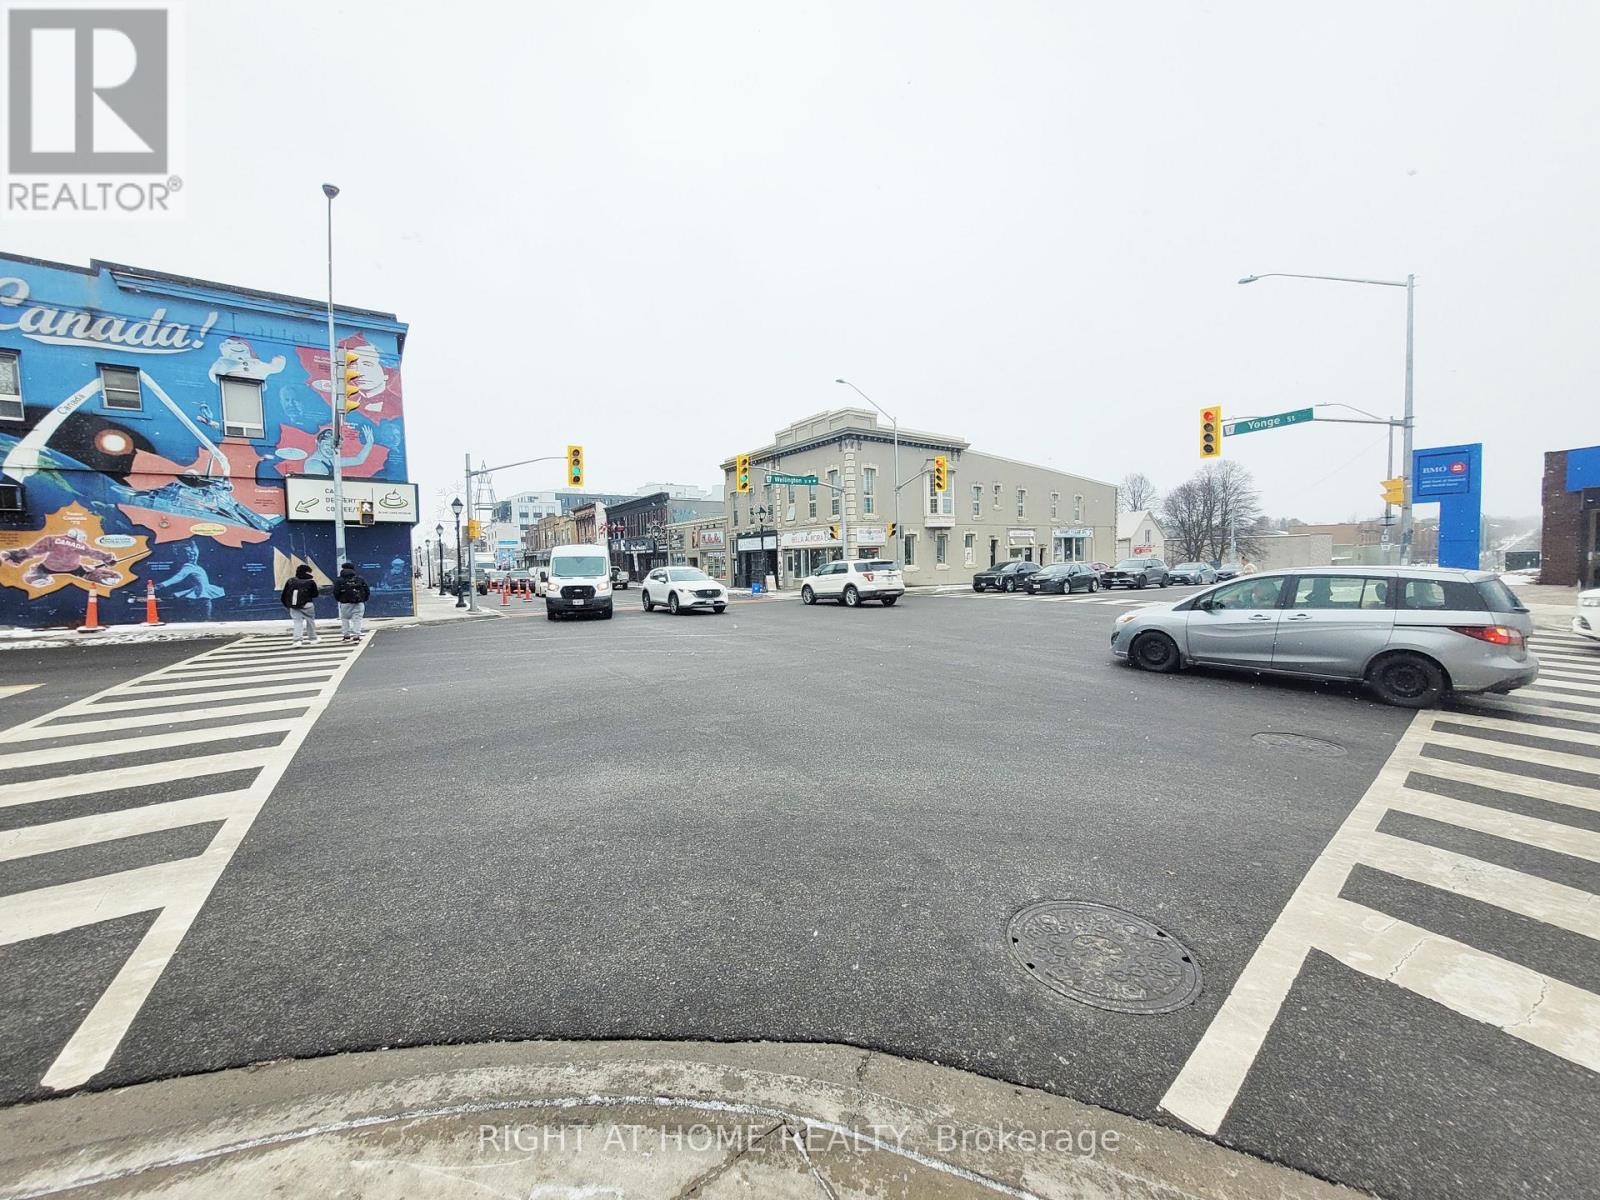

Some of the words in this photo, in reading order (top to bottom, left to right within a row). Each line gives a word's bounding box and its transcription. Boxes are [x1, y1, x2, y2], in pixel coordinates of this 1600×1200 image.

[1248, 417, 1281, 430] Yonge
[1286, 415, 1297, 423] St
[1422, 465, 1448, 474] BMO
[774, 476, 803, 486] Wellington
[54, 537, 86, 551] CANADA
